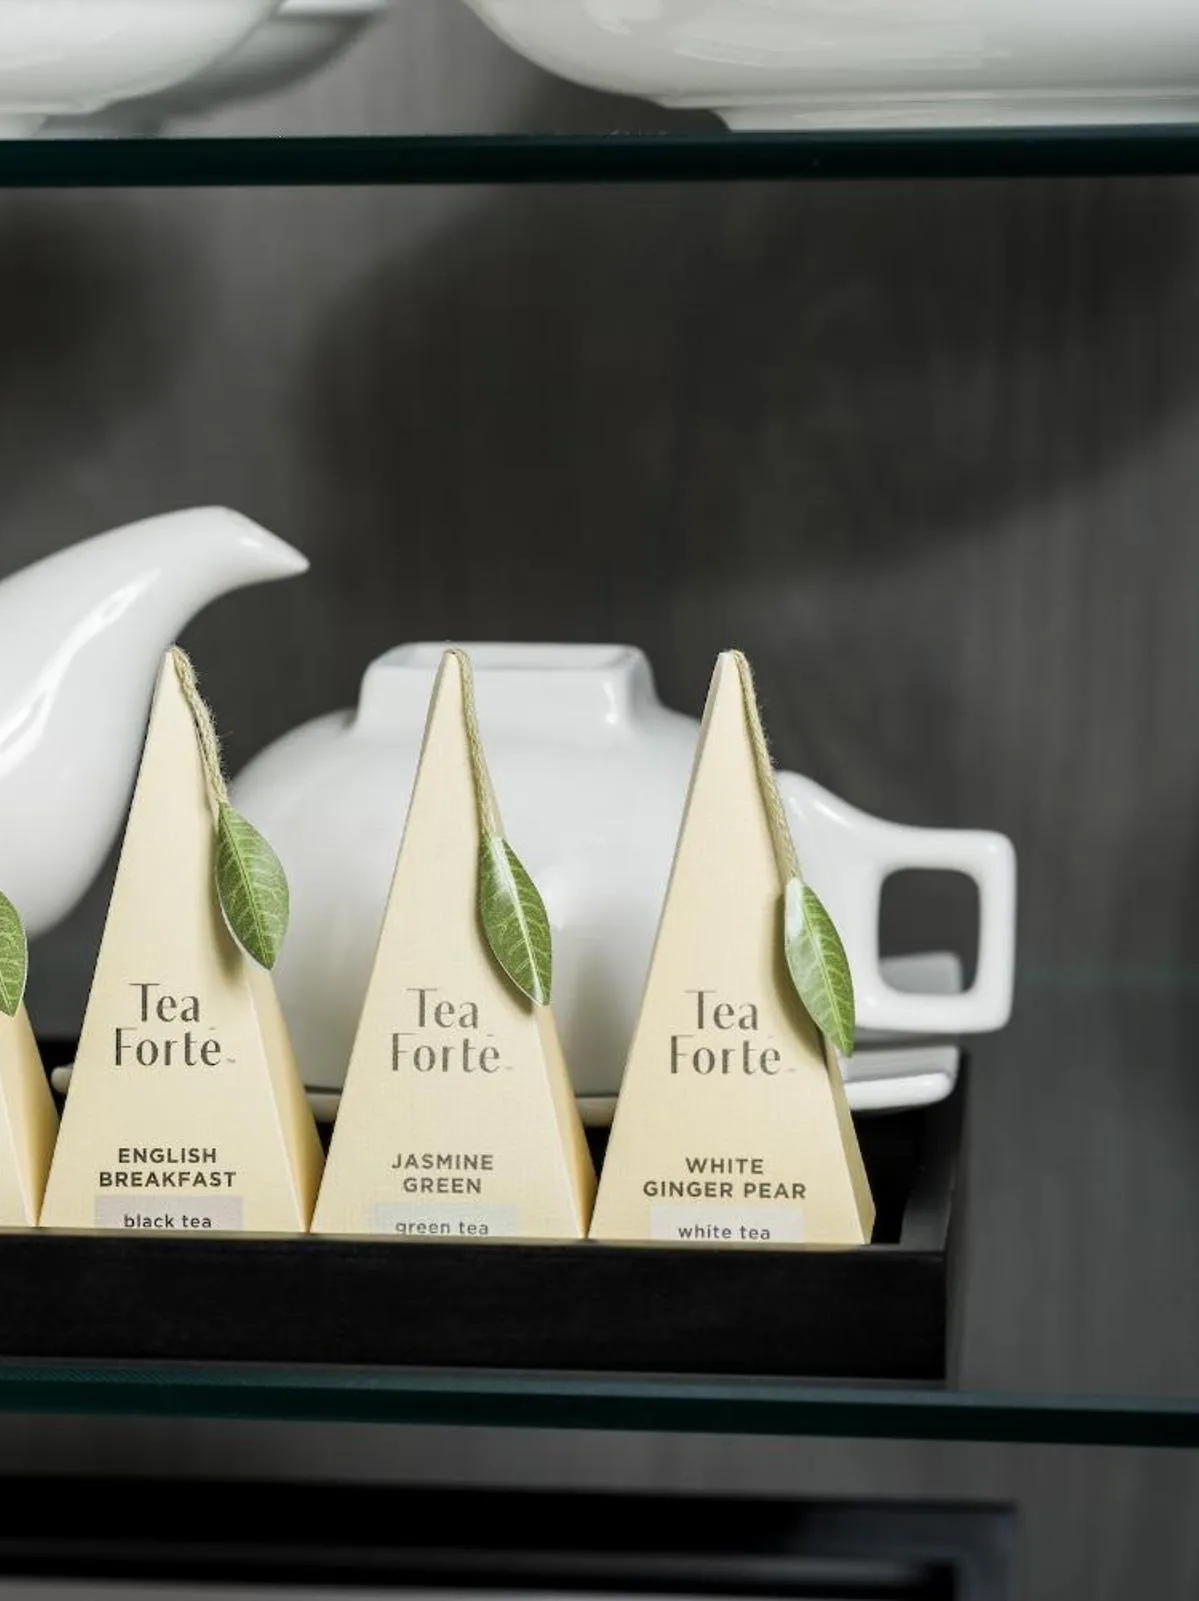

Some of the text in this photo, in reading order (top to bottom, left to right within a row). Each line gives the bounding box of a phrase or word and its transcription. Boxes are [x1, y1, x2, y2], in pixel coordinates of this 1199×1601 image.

[128, 982, 200, 1022] Tea
[406, 987, 478, 1028] Tea
[684, 989, 758, 1030] Tea
[118, 1148, 217, 1163] ENGLISH
[391, 1153, 494, 1170] JASMINE
[685, 1157, 764, 1174] WHITE
[99, 1171, 237, 1187] BREAKFAST
[403, 1177, 482, 1194] GREEN
[643, 1181, 807, 1199] GINGER PEAR
[123, 1213, 212, 1228] black tea
[395, 1221, 489, 1235] green tea
[678, 1224, 771, 1239] white tea
